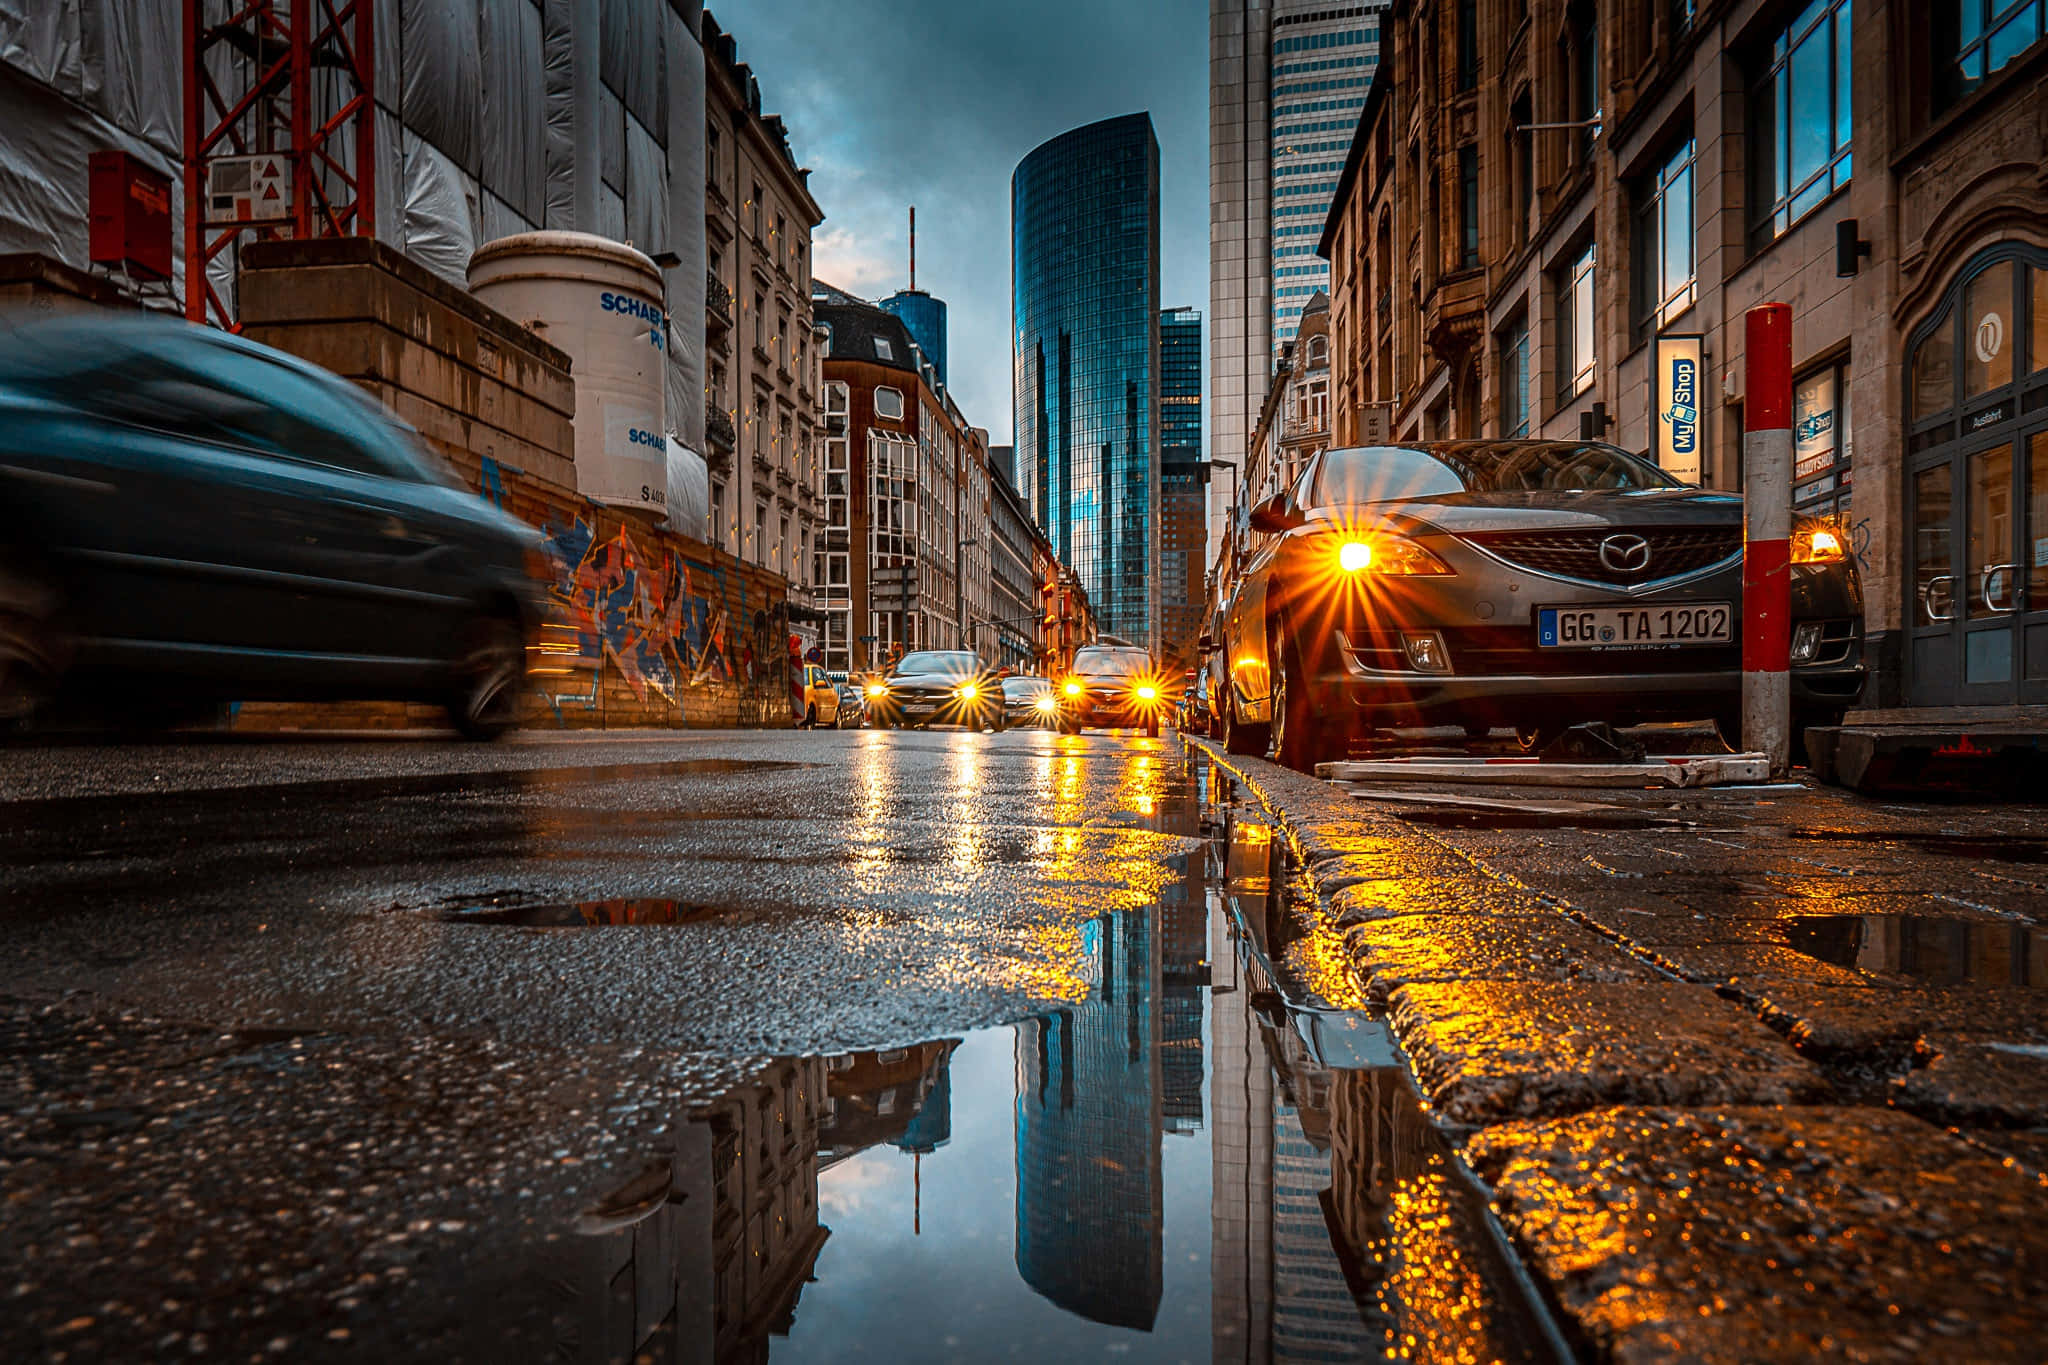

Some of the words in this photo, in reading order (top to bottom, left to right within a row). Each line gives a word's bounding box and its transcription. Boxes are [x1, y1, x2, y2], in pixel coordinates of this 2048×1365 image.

[1674, 364, 1694, 403] Shop
[1675, 424, 1693, 449] My
[641, 485, 650, 502] S
[1561, 613, 1595, 641] GG
[1617, 611, 1652, 641] TA
[1659, 608, 1727, 639] 1202
